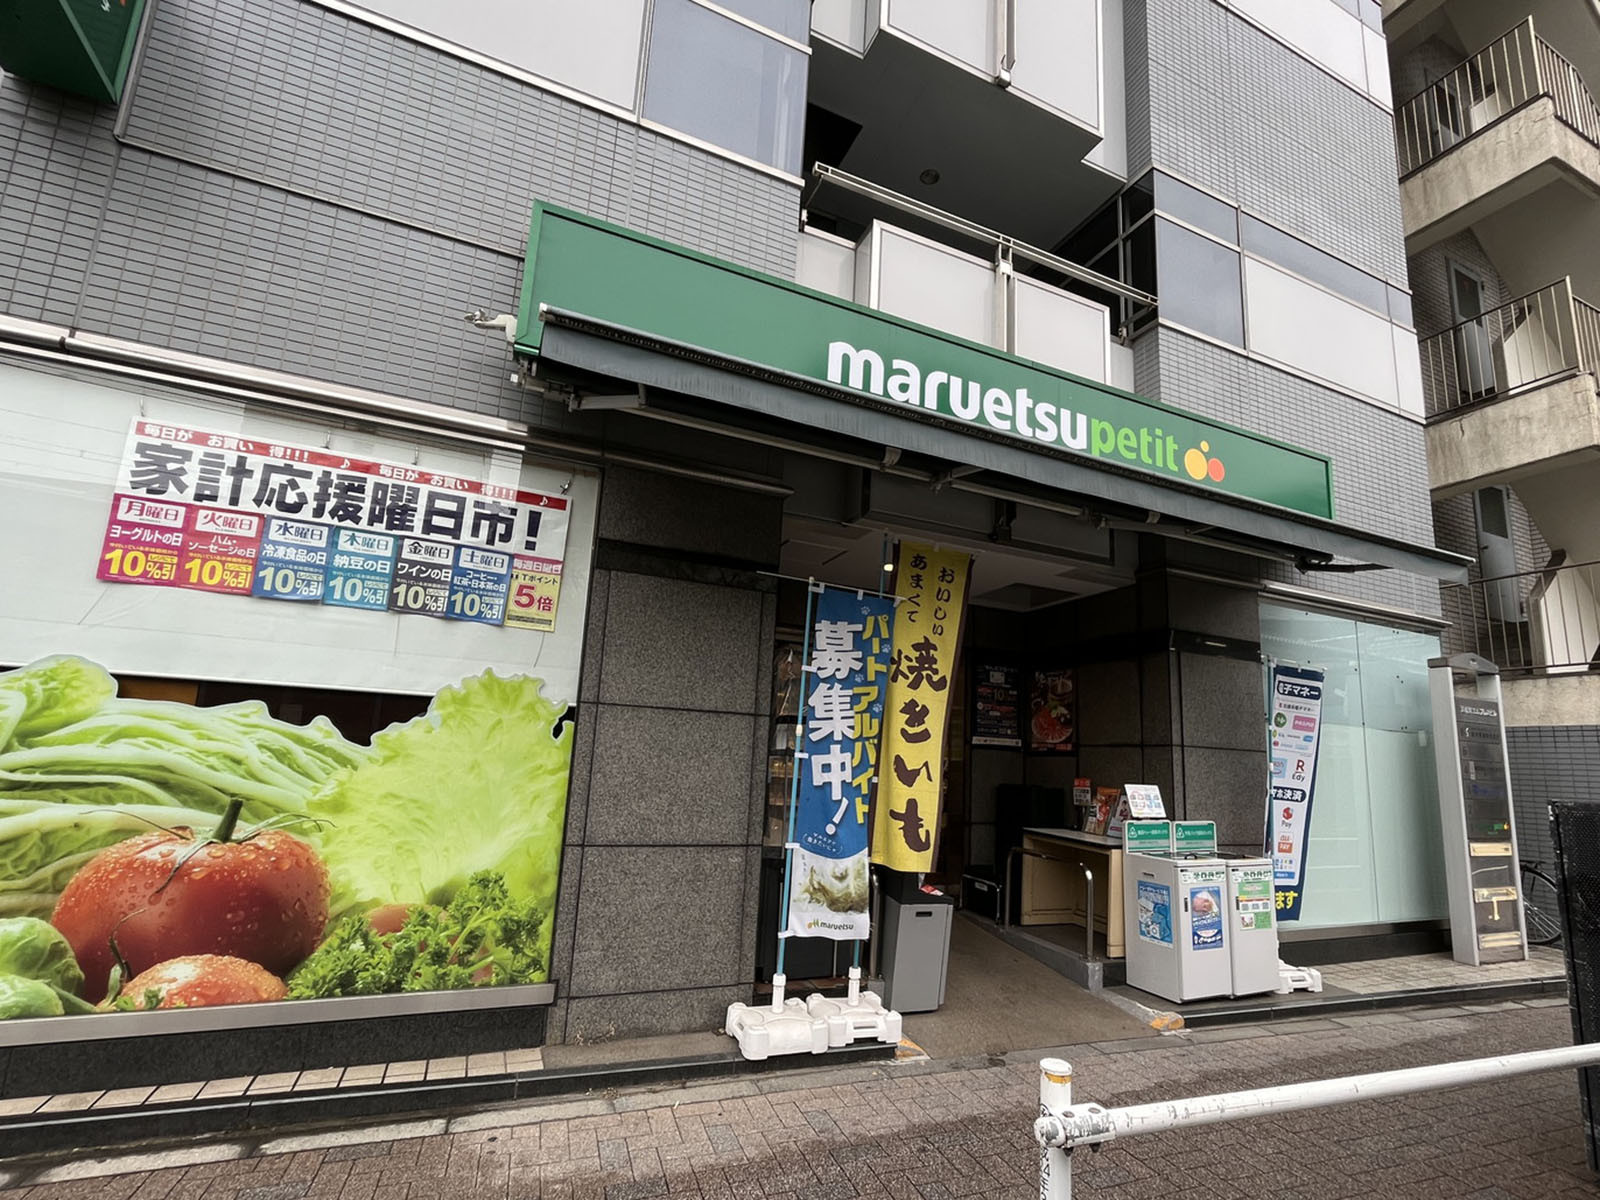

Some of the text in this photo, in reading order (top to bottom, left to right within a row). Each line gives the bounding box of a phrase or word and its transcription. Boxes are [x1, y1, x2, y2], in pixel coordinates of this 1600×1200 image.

[828, 341, 1179, 472] maruetsu petit
[144, 424, 194, 442] 毎日が
[208, 435, 254, 450] お買い
[379, 464, 419, 482] 毎日が
[430, 475, 468, 490] お買い
[124, 500, 179, 521] 月曜日
[202, 512, 252, 530] 火曜日
[110, 525, 183, 546] ヨーグルトの日
[275, 522, 323, 540] 水曜日
[344, 533, 388, 550] 木曜日
[188, 541, 256, 558] ソーセージの日
[262, 544, 327, 565] 冷凍食品の日
[407, 542, 450, 559] 金曜日
[464, 551, 505, 568] 土曜日
[104, 548, 176, 580] 10%引
[184, 558, 251, 588] 10%引
[333, 554, 390, 574] 納豆の日
[397, 562, 452, 582] ワインの日
[258, 566, 322, 596] 10%引
[328, 576, 388, 604] 10%引
[908, 553, 928, 622] あまくて
[392, 584, 448, 612] 10%引
[450, 591, 502, 619] 10%引
[514, 584, 553, 612] 5倍
[932, 567, 955, 636] おいしい
[808, 620, 864, 836] 募集中!
[852, 614, 890, 824] パートアルバイト
[889, 635, 948, 853] 焼きいも
[820, 922, 854, 930] maruetsu
